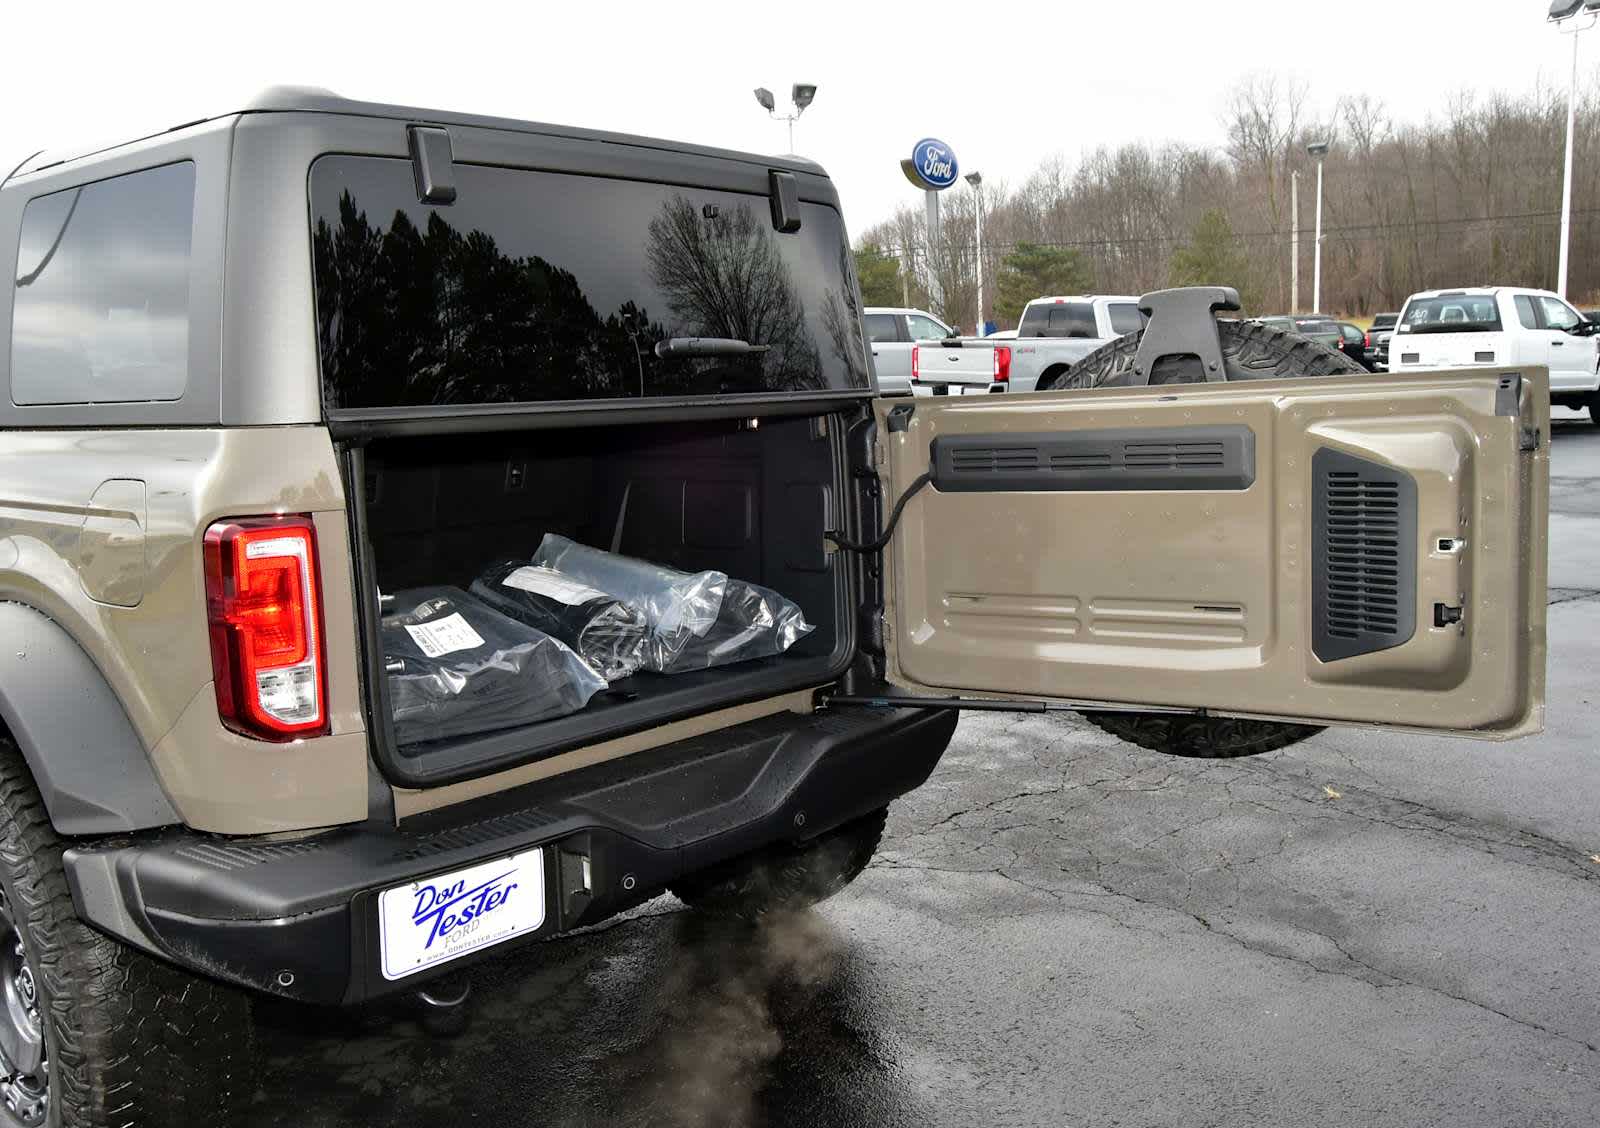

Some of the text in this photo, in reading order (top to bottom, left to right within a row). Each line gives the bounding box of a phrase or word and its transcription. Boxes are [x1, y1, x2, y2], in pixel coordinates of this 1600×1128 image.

[924, 146, 952, 179] Ford
[412, 879, 465, 919] Don
[415, 868, 518, 949] Tester
[444, 919, 480, 948] FORD
